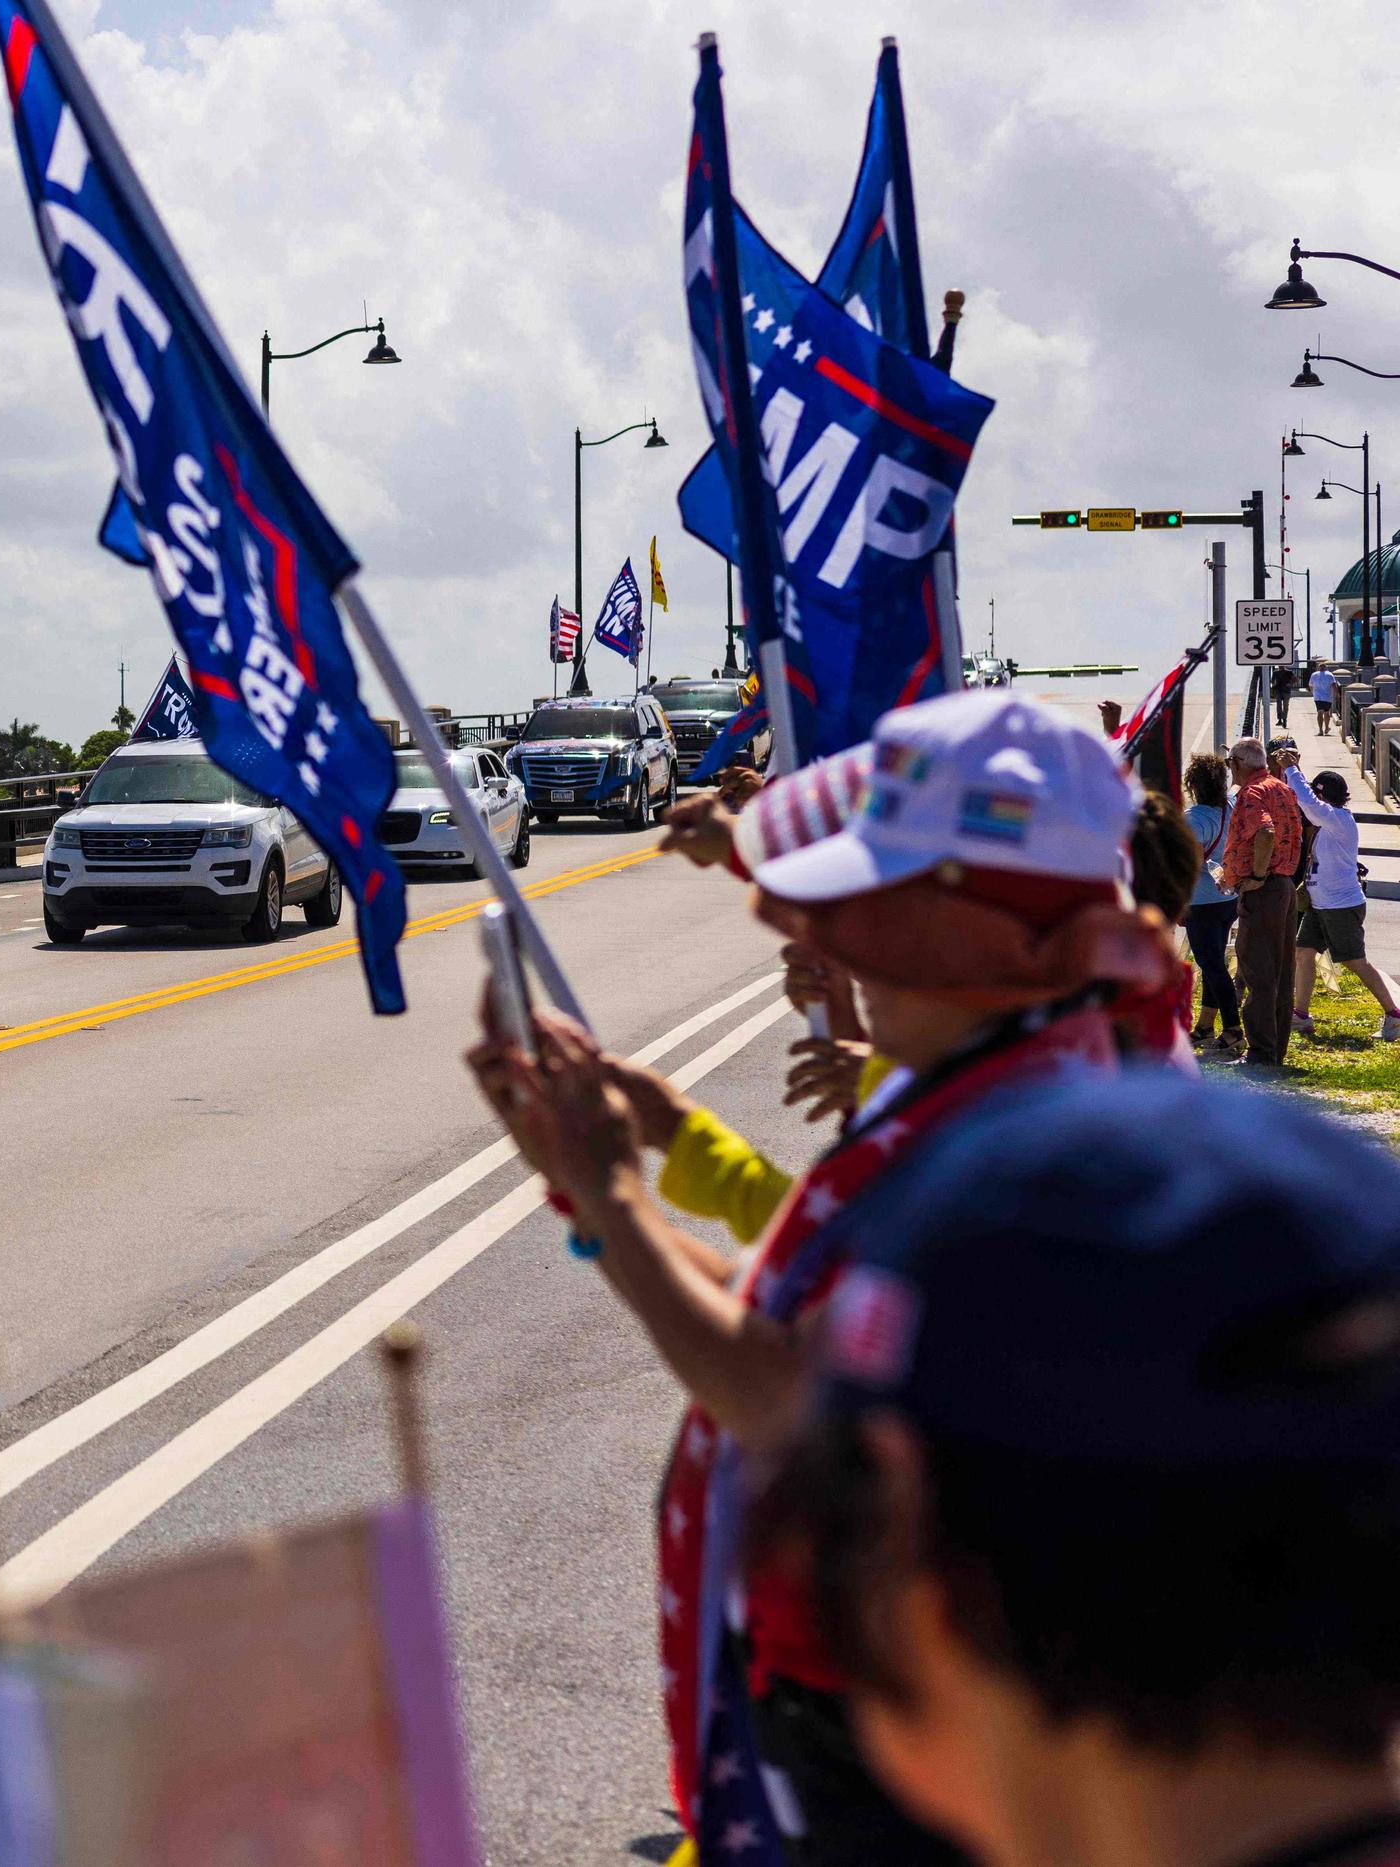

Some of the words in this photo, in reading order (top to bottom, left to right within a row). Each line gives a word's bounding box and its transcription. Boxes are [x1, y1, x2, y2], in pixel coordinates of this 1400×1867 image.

[750, 363, 955, 589] MP
[1243, 607, 1287, 617] SPEED
[1248, 622, 1281, 632] LIMIT
[1244, 636, 1286, 660] 35
